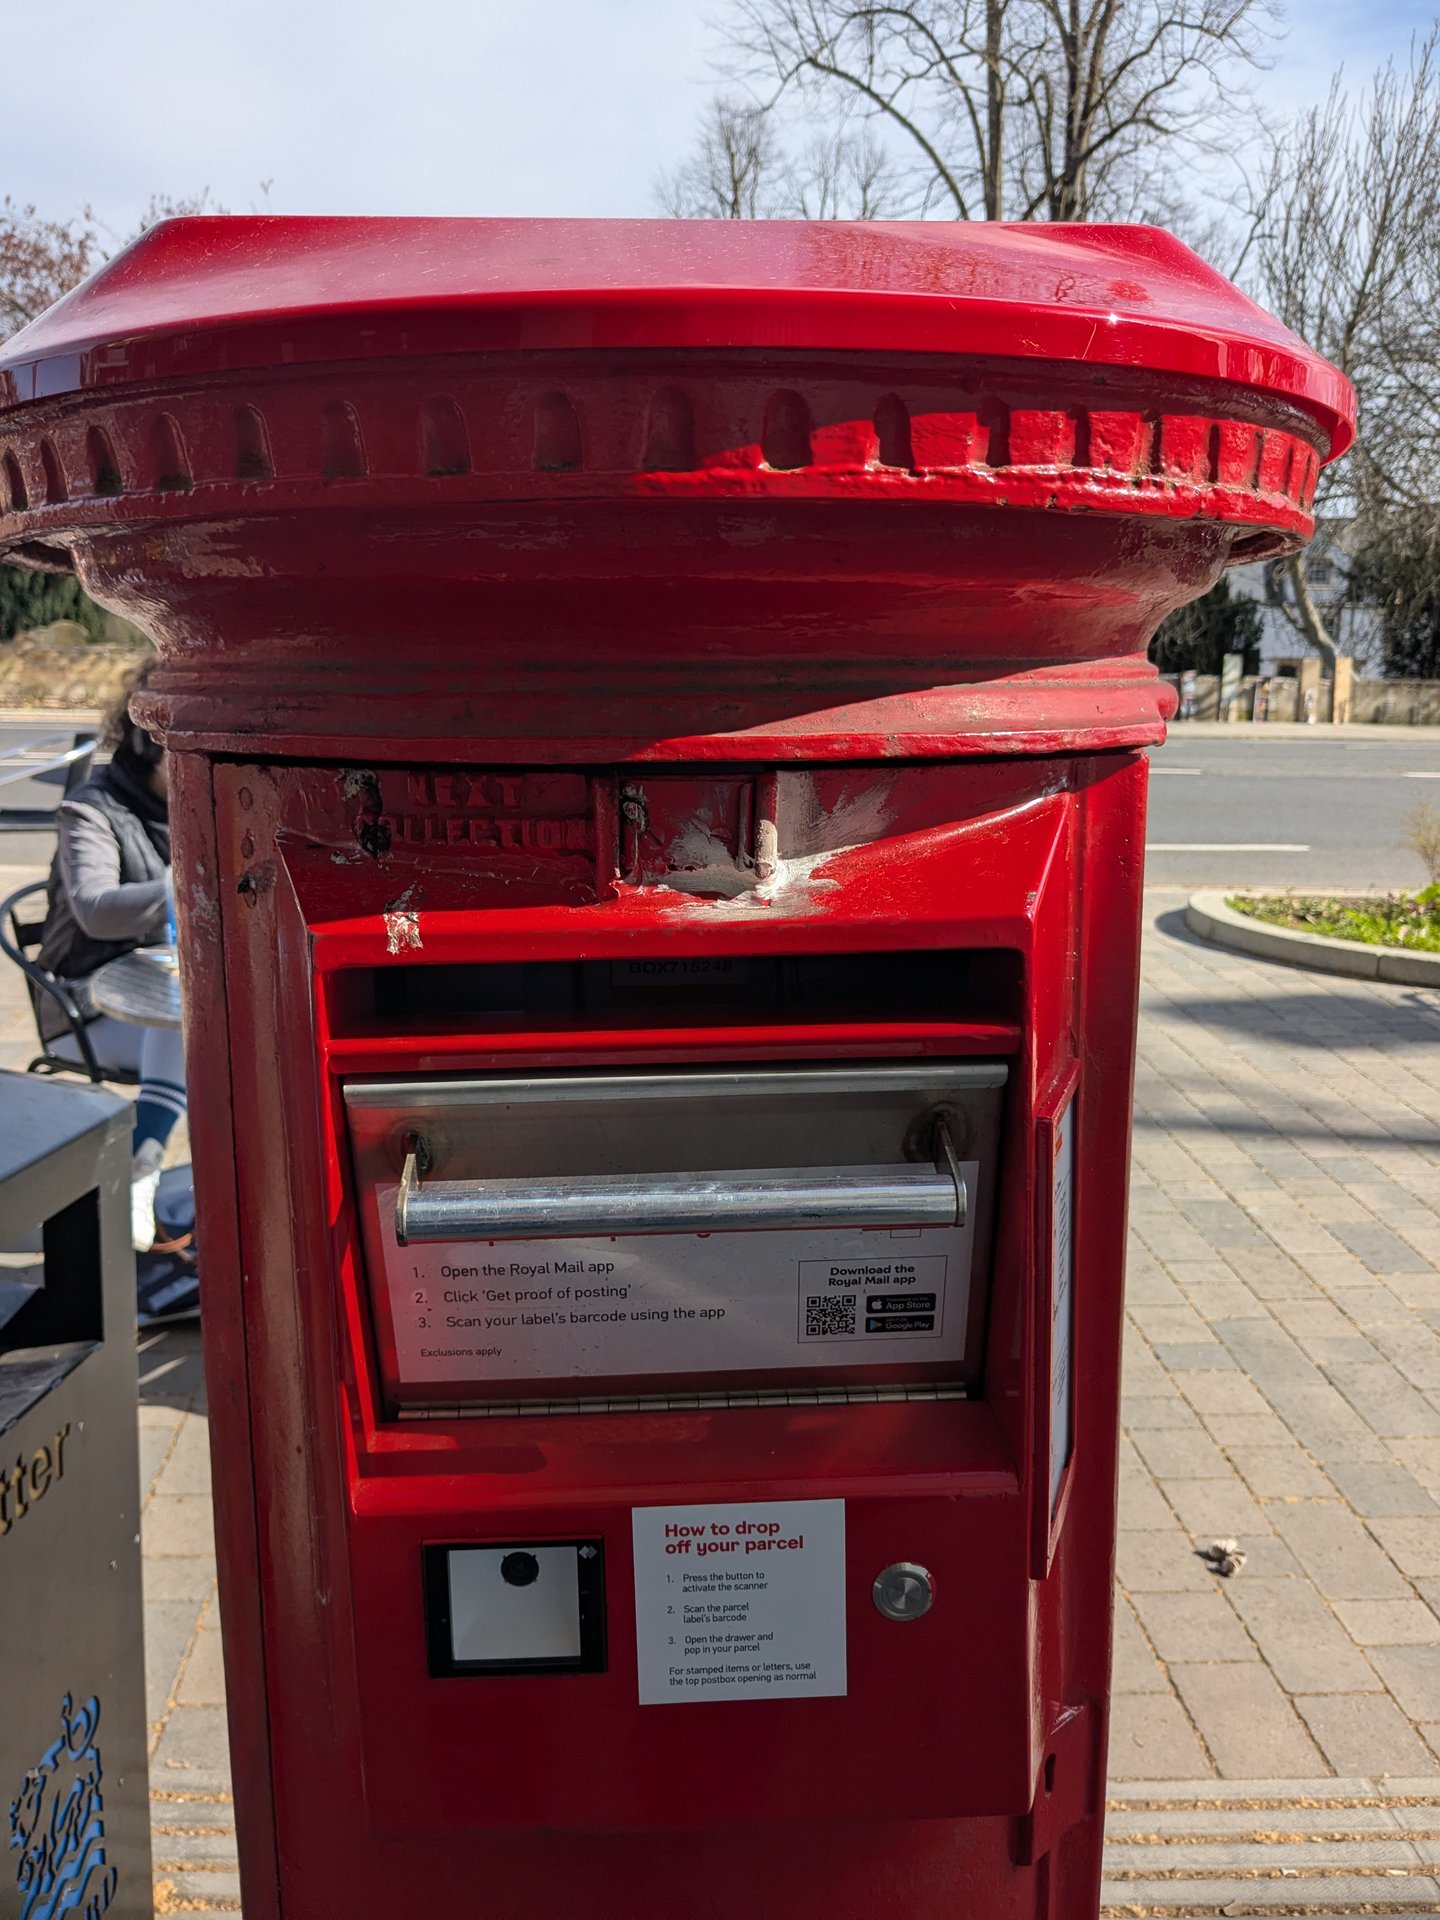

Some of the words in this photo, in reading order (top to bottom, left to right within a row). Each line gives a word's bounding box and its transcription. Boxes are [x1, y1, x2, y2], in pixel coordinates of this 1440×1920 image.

[408, 773, 522, 806] NEXT
[413, 1267, 425, 1279] 1.
[441, 1266, 478, 1279] Open
[482, 1264, 505, 1276] the
[510, 1262, 550, 1277] Royal
[554, 1261, 584, 1273] Mail
[588, 1262, 614, 1274] app
[830, 1265, 891, 1276] Download
[895, 1265, 915, 1274] the
[828, 1277, 861, 1287] Royal
[865, 1276, 890, 1285] Mail
[893, 1276, 916, 1285] app
[415, 1292, 428, 1304] 2.
[444, 1290, 478, 1302] Click
[515, 1288, 553, 1302] proof
[557, 1287, 571, 1299] of
[886, 1301, 905, 1310] App
[906, 1301, 931, 1309] Store
[418, 1317, 431, 1328] 3.
[446, 1316, 481, 1327] Scan
[485, 1316, 517, 1329] your
[521, 1313, 566, 1325] label's
[570, 1310, 627, 1323] barcode
[630, 1309, 669, 1322] using
[673, 1308, 696, 1319] the
[700, 1308, 725, 1320] app
[886, 1321, 914, 1330] Google
[914, 1321, 930, 1329] Play
[421, 1348, 473, 1357] Exclusions
[476, 1347, 502, 1357] apply
[665, 1524, 705, 1538] How
[710, 1523, 730, 1536] to
[735, 1521, 780, 1537] drop
[665, 1539, 692, 1554] off
[696, 1541, 740, 1556] your
[745, 1535, 804, 1555] parcel
[666, 1575, 674, 1583] 1.
[682, 1573, 708, 1582] Press
[709, 1572, 724, 1581] the
[725, 1571, 754, 1581] button
[755, 1571, 765, 1580] to
[682, 1583, 716, 1593] activate
[718, 1582, 732, 1591] the
[734, 1582, 768, 1591] scanner
[667, 1605, 675, 1614] 2.
[683, 1605, 705, 1613] Scan
[706, 1603, 721, 1612] the
[722, 1602, 749, 1613] parcel
[683, 1614, 711, 1624] label's
[712, 1613, 747, 1622] barcode
[668, 1636, 676, 1645] 3.
[684, 1635, 708, 1646] Open
[709, 1634, 723, 1643] the
[725, 1633, 755, 1642] drawer
[757, 1632, 774, 1641] and
[684, 1646, 700, 1656] pop
[702, 1645, 711, 1653] in
[712, 1645, 733, 1655] your
[734, 1643, 760, 1654] parcel
[669, 1667, 684, 1675] For
[686, 1665, 724, 1675] stamped
[725, 1664, 750, 1673] items
[752, 1664, 762, 1672] or
[763, 1662, 793, 1672] letters,
[795, 1662, 810, 1670] use
[669, 1677, 684, 1686] the
[685, 1677, 699, 1686] top
[701, 1674, 736, 1685] postbox
[737, 1673, 771, 1683] opening
[773, 1673, 784, 1681] as
[785, 1671, 816, 1681] normal
